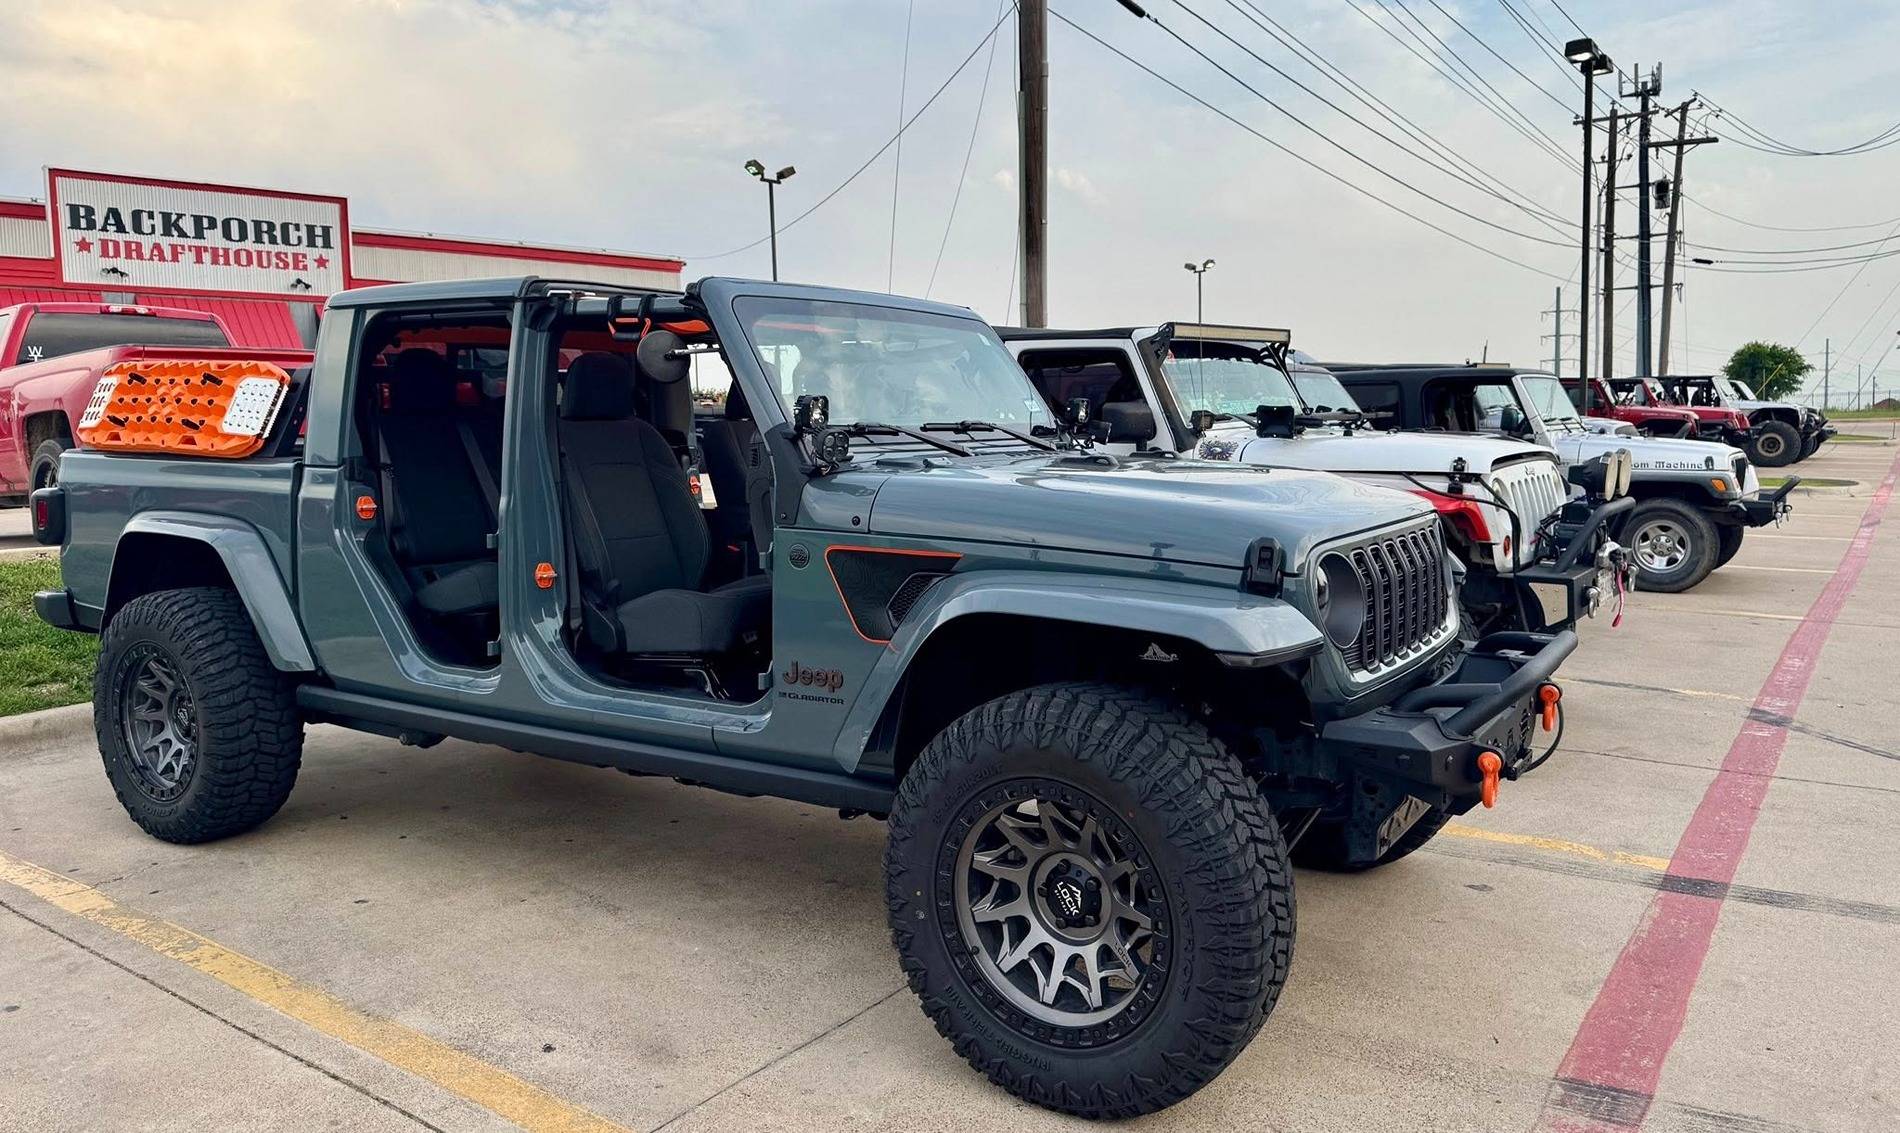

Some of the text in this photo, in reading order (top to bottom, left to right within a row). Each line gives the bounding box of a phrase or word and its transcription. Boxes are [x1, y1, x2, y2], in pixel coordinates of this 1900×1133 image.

[66, 203, 334, 249] BACKPORCH
[98, 237, 308, 272] DRAFTHOUSE
[783, 660, 843, 693] Jeep
[788, 692, 844, 705] GLADIATOR
[1056, 881, 1080, 916] LOCK
